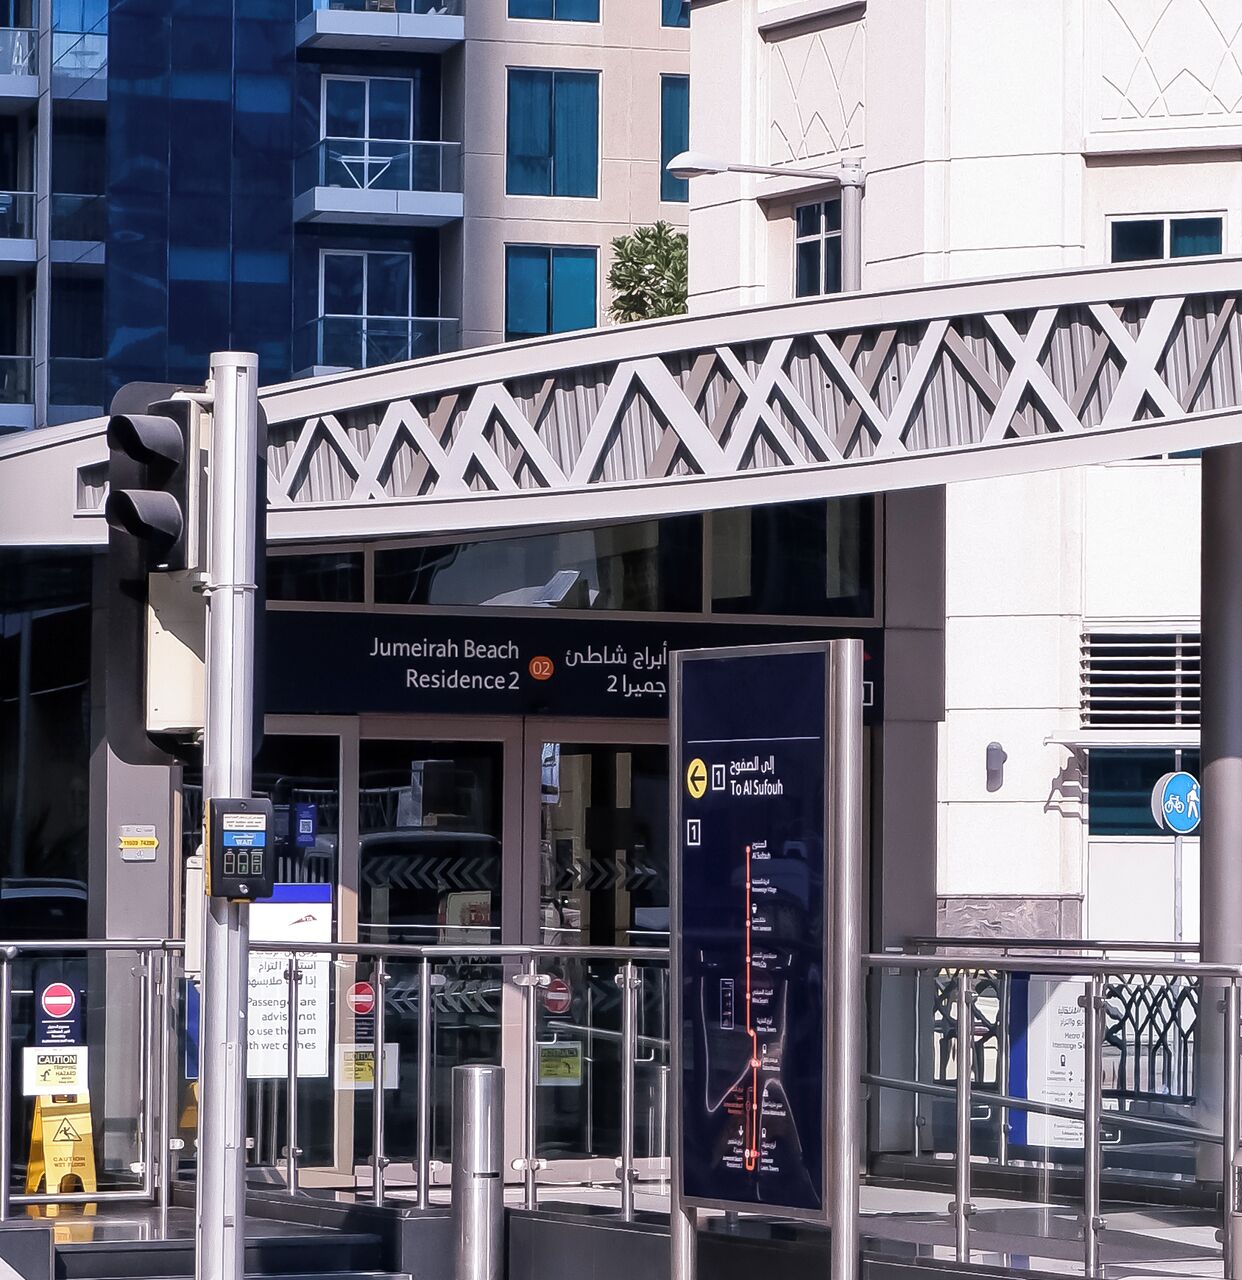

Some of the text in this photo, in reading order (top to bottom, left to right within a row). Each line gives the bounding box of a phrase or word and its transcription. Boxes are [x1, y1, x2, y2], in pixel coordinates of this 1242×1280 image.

[370, 637, 519, 659] Jumeirah Beach
[565, 640, 667, 669] أبراج شاطئ
[532, 661, 551, 676] 02
[406, 669, 520, 689] Residence 2
[607, 674, 666, 698] جميرا 2
[731, 778, 784, 796] To Al Sufouh
[299, 999, 317, 1007] are
[298, 1013, 317, 1021] not
[248, 1028, 256, 1036] o
[256, 1028, 274, 1036] use
[275, 1026, 290, 1036] th
[260, 1041, 281, 1050] wet
[37, 1055, 77, 1064] CAUTION
